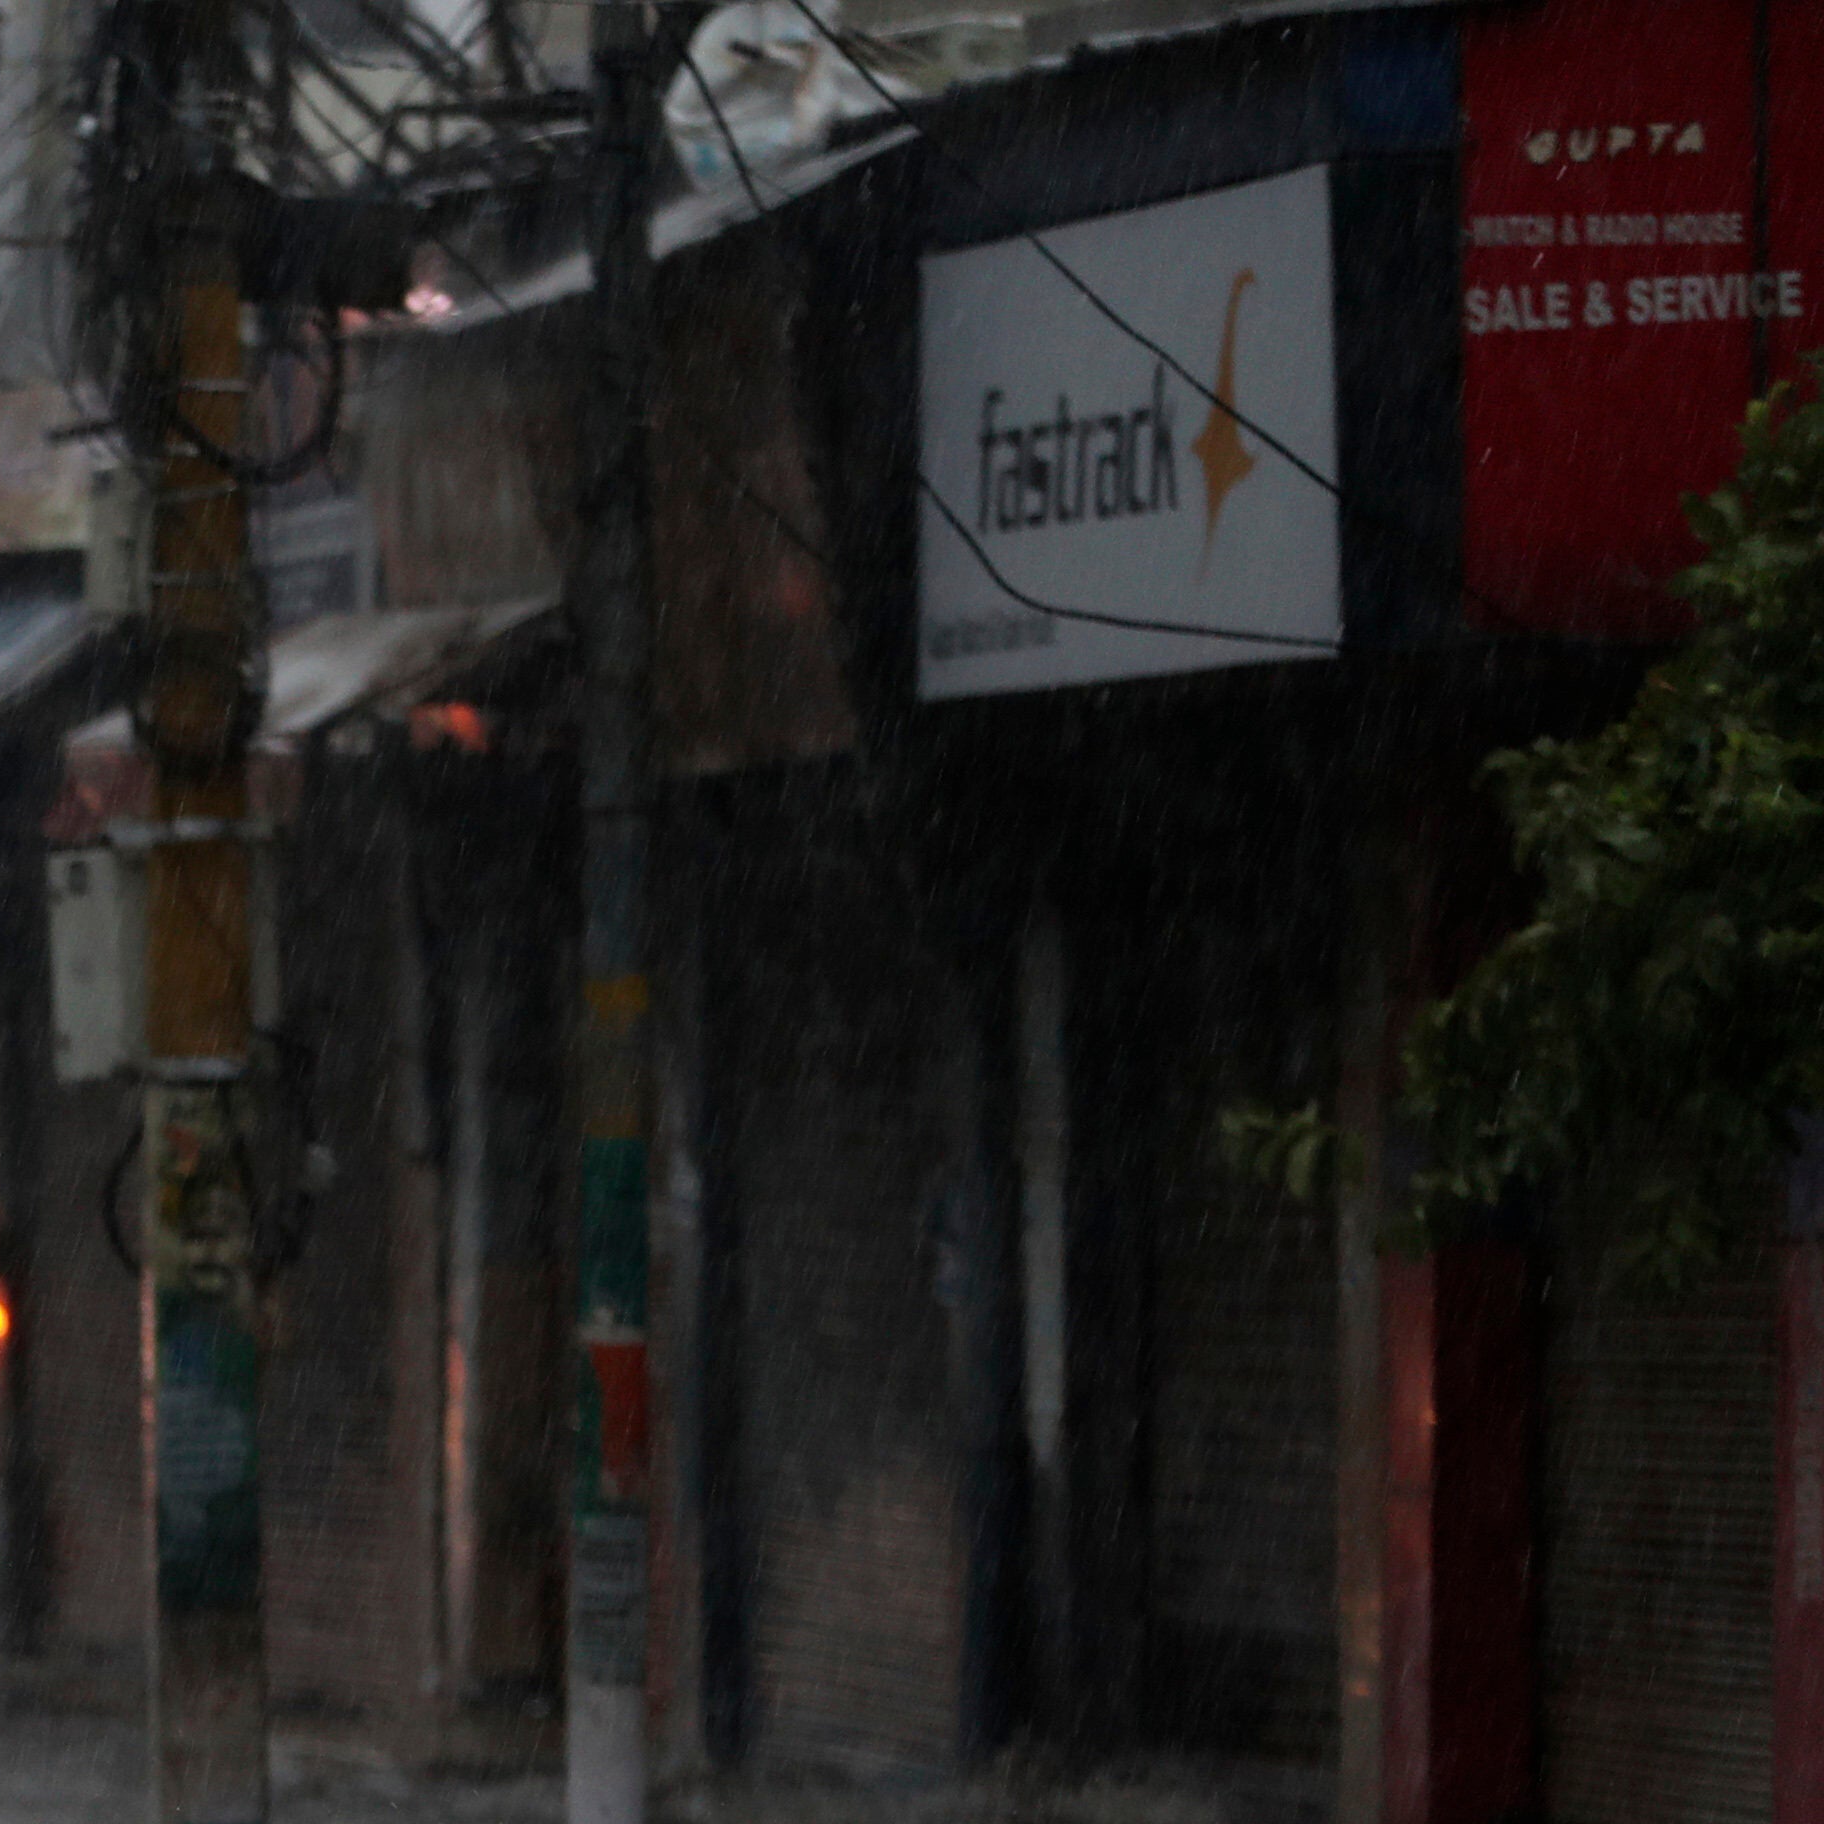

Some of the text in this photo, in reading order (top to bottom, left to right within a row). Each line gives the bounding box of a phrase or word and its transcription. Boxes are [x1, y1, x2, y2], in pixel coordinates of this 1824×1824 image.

[1526, 121, 1705, 164] GUPTA
[1561, 214, 1580, 246] &
[1584, 213, 1658, 245] RADIO
[1663, 212, 1744, 243] HOUSE
[1464, 270, 1803, 336] SALE & SERVICE
[978, 362, 1179, 534] fastrack
